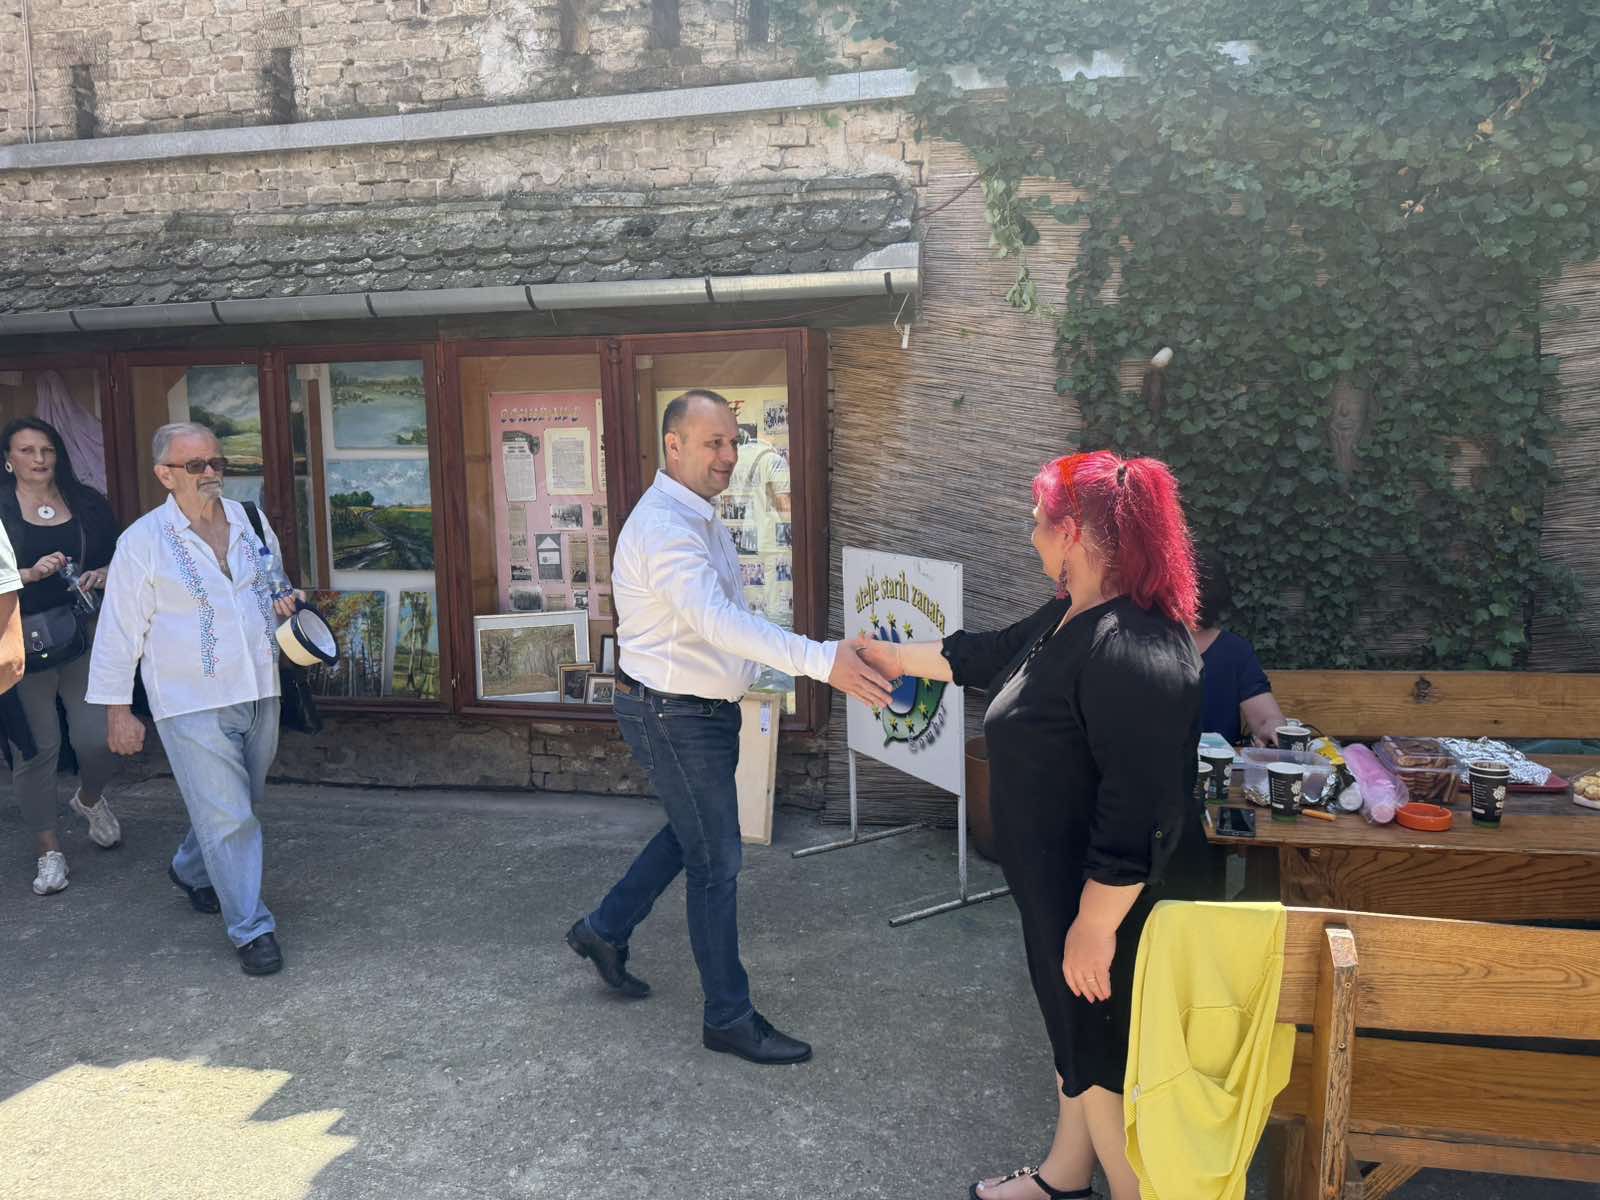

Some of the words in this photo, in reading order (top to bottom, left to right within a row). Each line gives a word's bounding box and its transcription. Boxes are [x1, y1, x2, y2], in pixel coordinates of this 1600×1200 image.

[855, 576, 880, 613] atelje
[880, 570, 909, 603] starih
[911, 585, 946, 636] zanata
